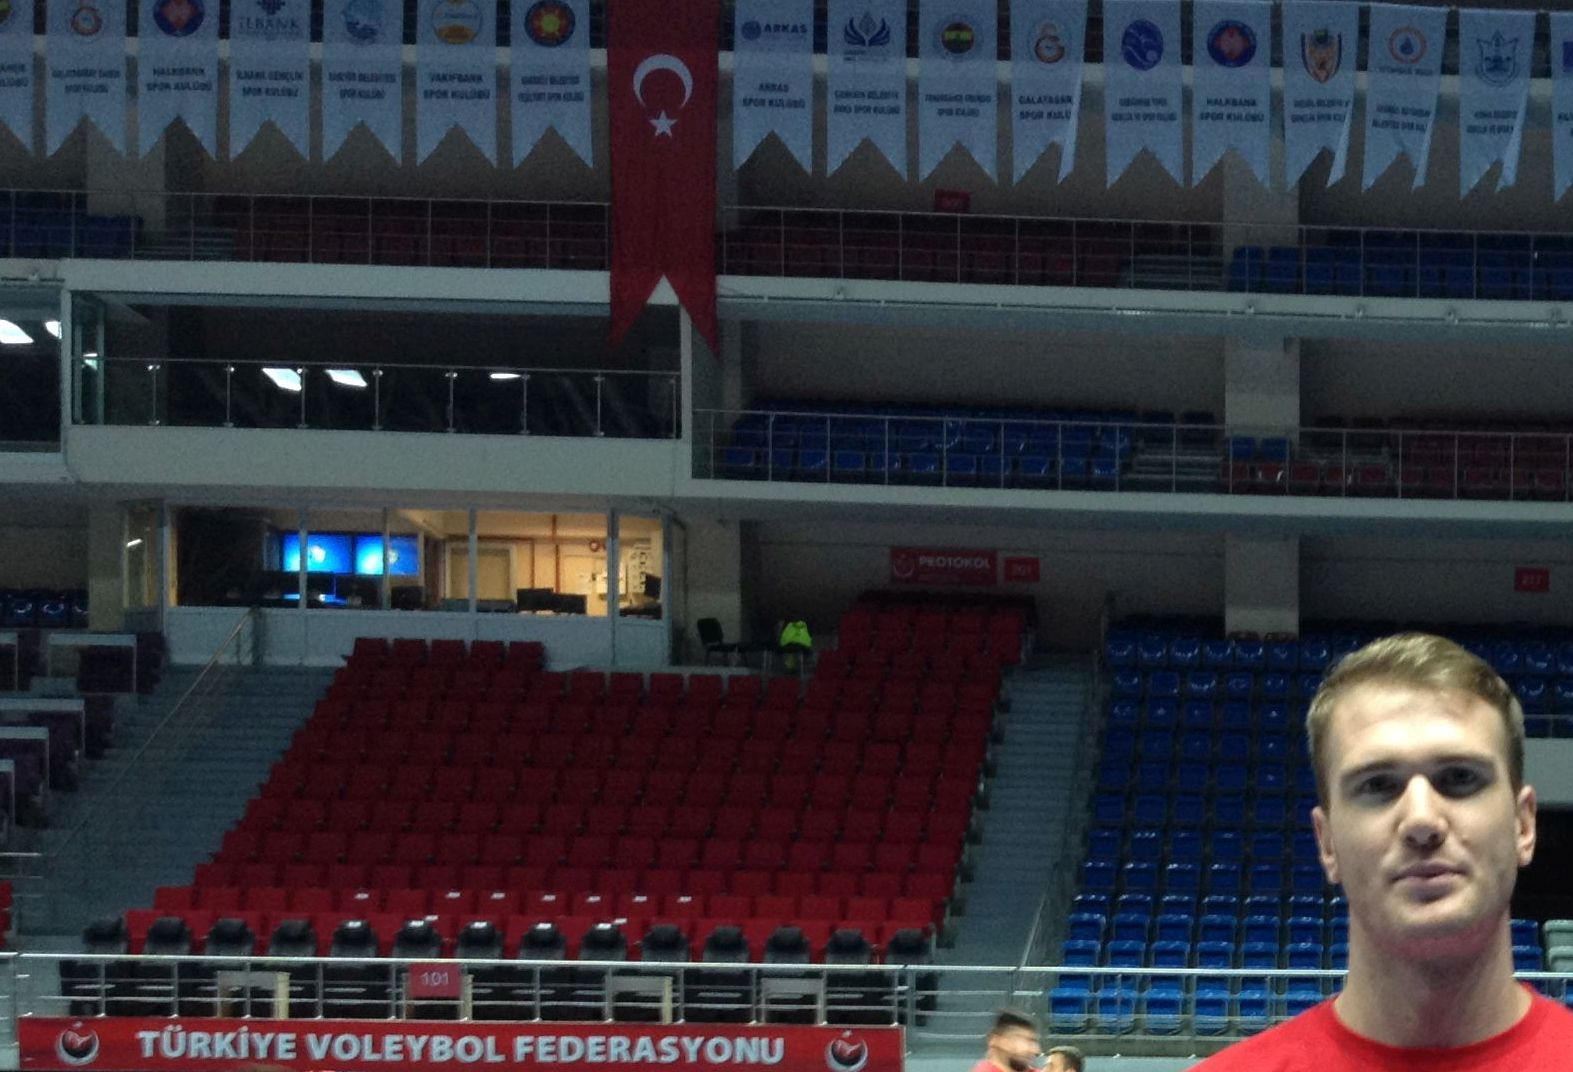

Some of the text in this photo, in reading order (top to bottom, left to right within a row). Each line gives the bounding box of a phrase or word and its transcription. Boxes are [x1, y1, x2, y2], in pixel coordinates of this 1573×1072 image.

[763, 23, 809, 34] ARKAS
[152, 68, 206, 77] HALKBANK
[430, 73, 484, 83] VAKIFBANK
[1206, 98, 1258, 107] HALKBANK
[421, 971, 450, 987] 101
[139, 1025, 786, 1066] TÜRKİYE VOLEYBOL FEDERASYONU
